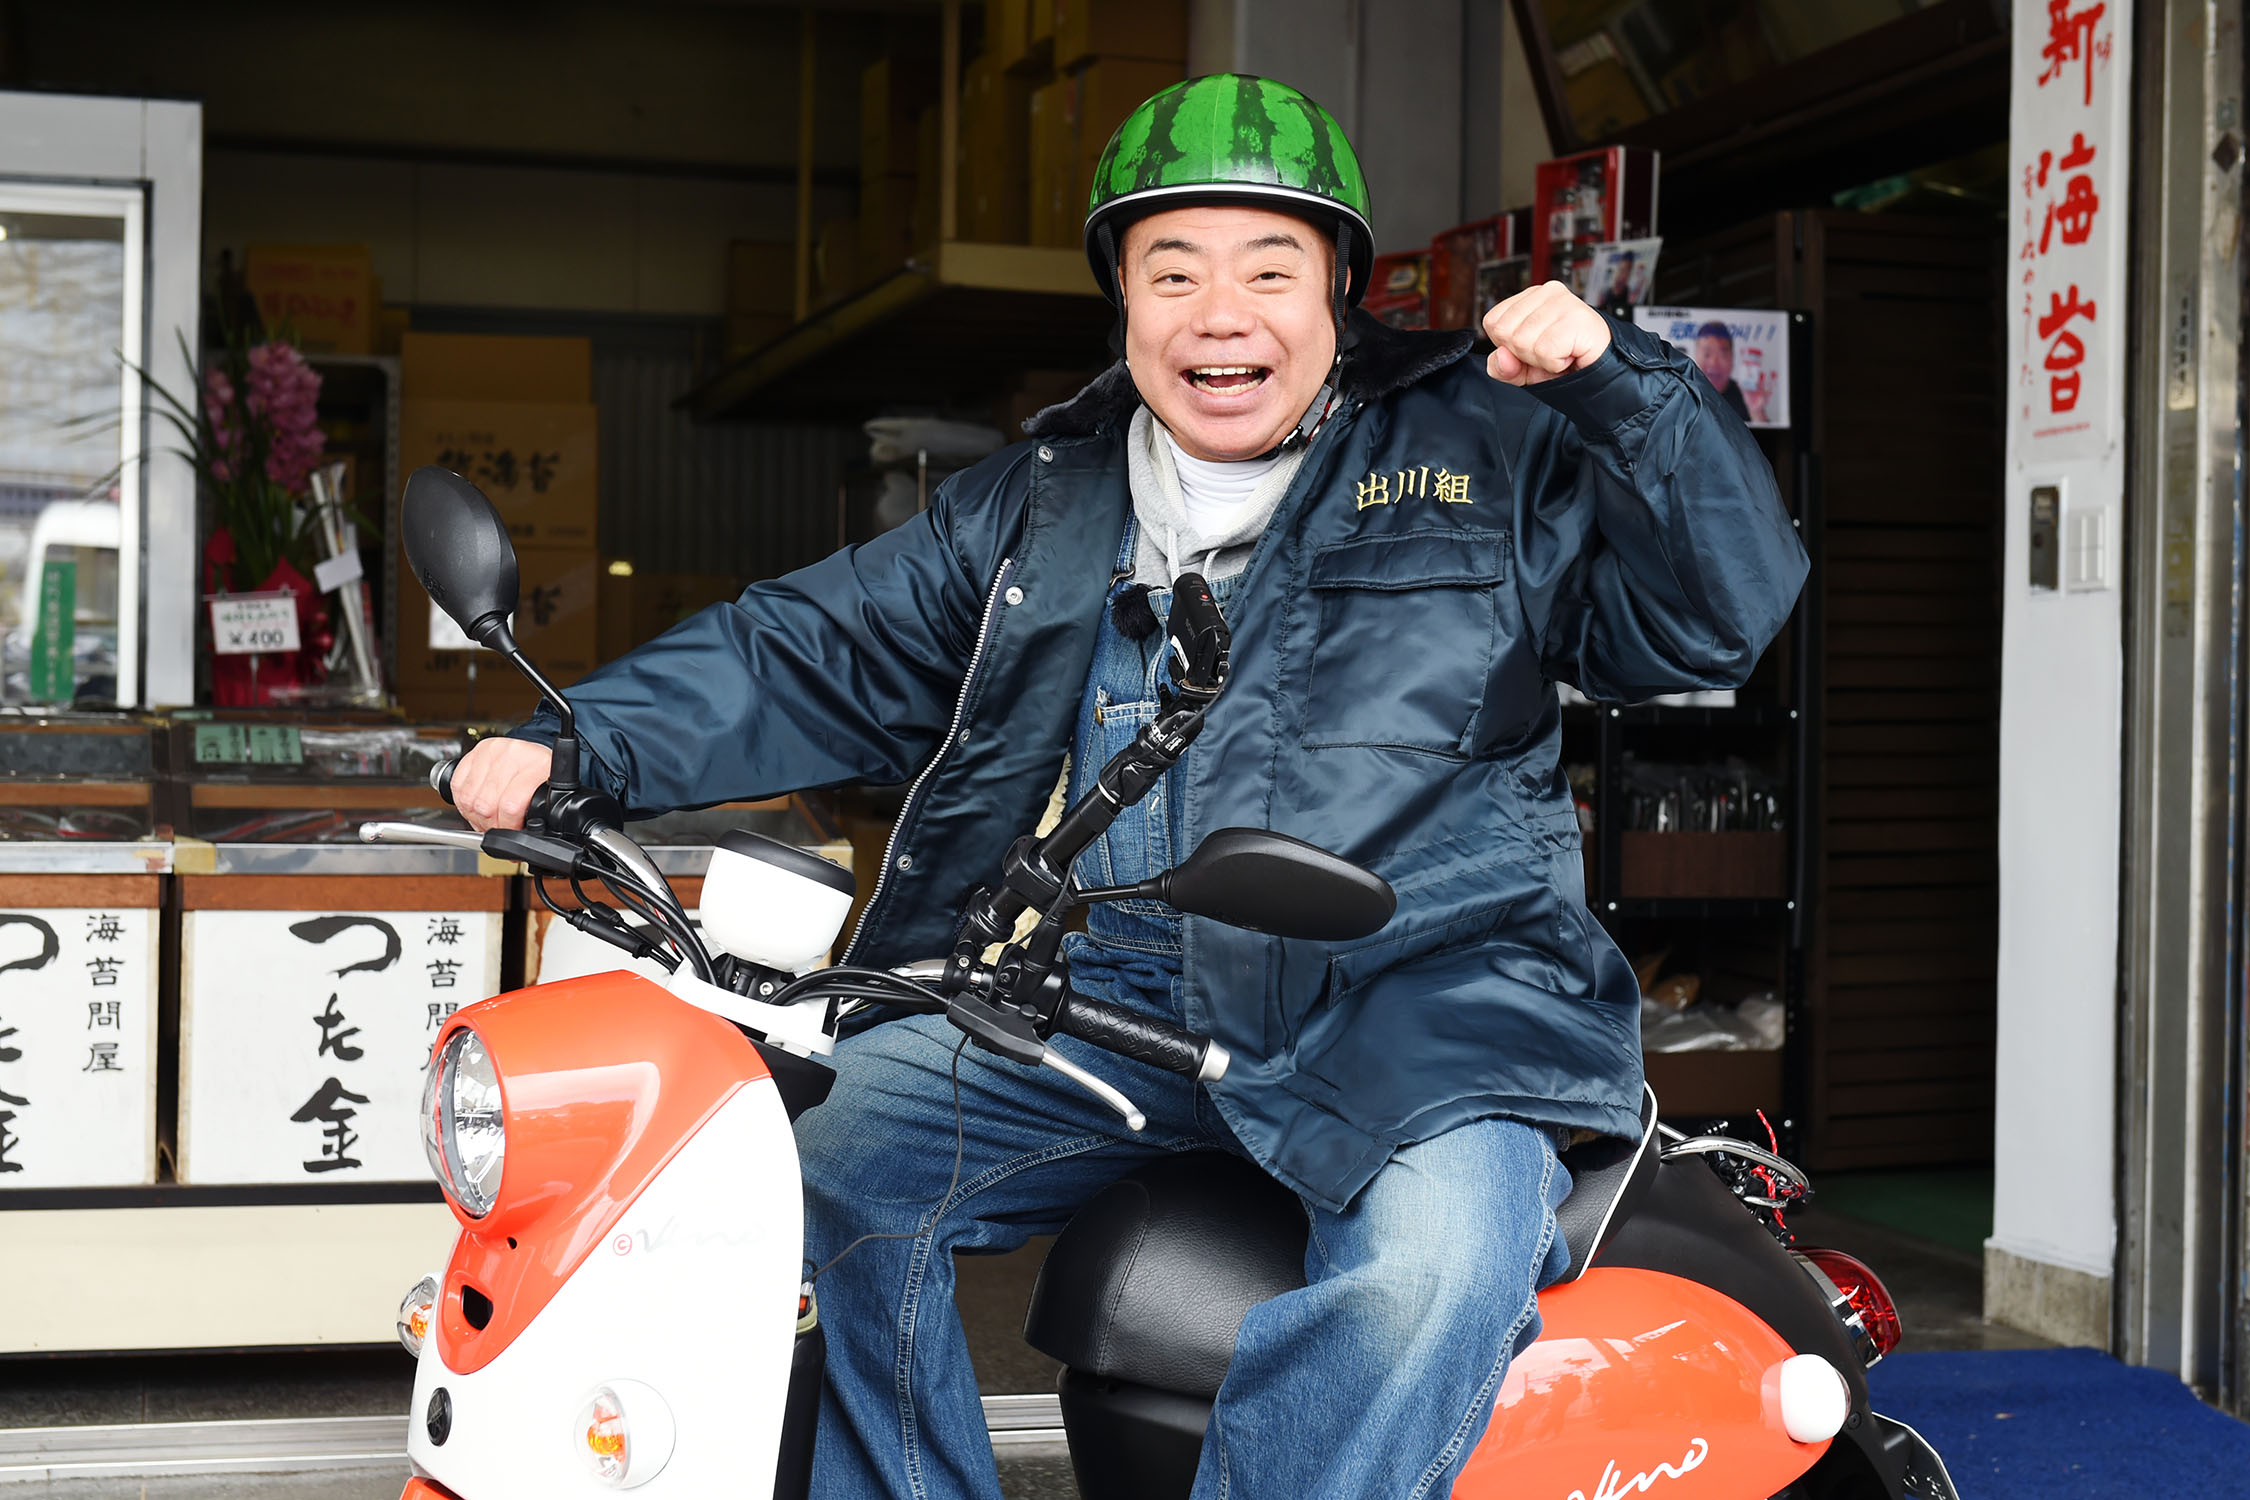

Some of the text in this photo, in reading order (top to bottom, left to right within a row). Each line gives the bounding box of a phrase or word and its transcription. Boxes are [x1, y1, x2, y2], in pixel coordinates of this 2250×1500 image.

[2037, 0, 2105, 414] 新海苔
[1356, 465, 1474, 512] 出川組
[82, 913, 126, 1073] 海苔問屋
[288, 914, 402, 1174] つた金
[420, 916, 466, 1071] 海苔問
